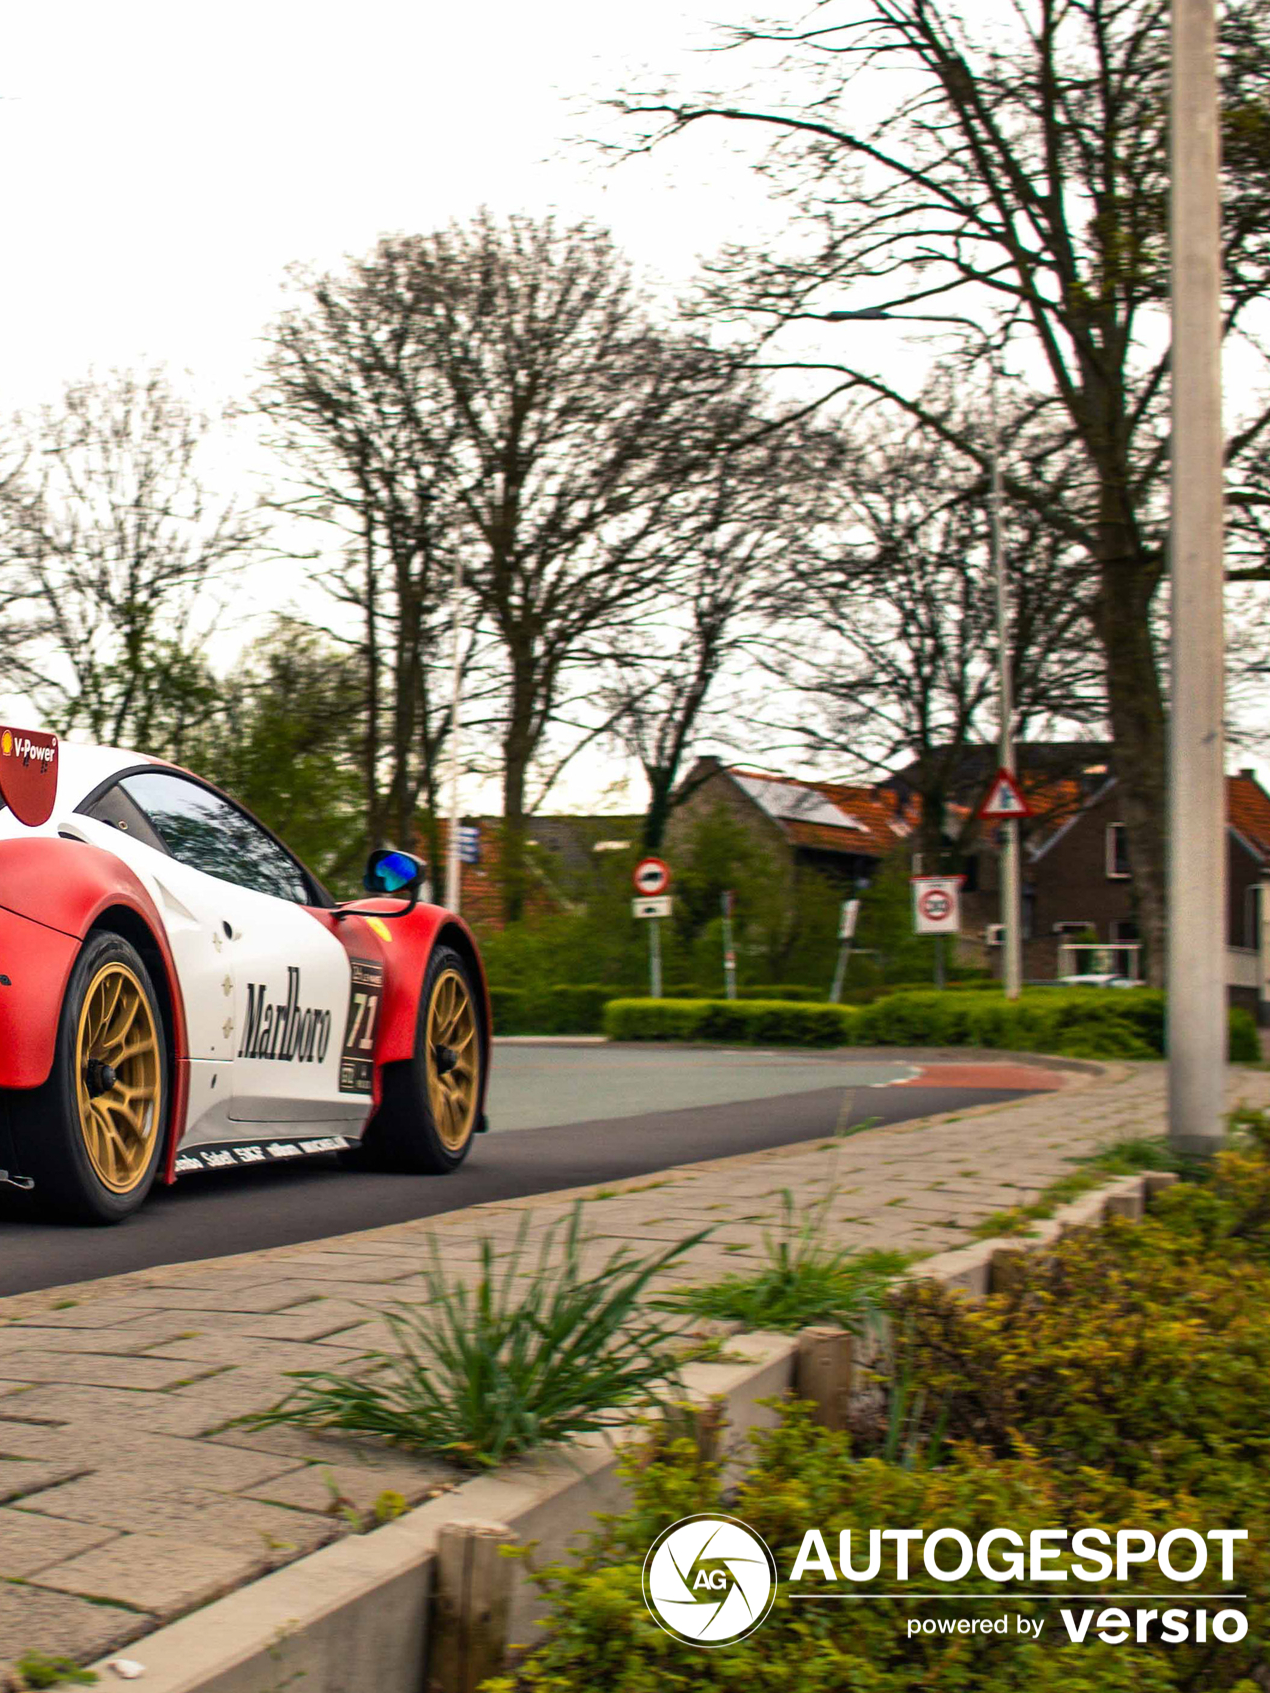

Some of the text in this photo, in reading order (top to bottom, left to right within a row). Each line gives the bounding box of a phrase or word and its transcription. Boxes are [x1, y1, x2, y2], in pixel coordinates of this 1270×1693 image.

[14, 737, 55, 762] V-Power
[237, 966, 331, 1063] Marlboro
[346, 993, 378, 1049] 71
